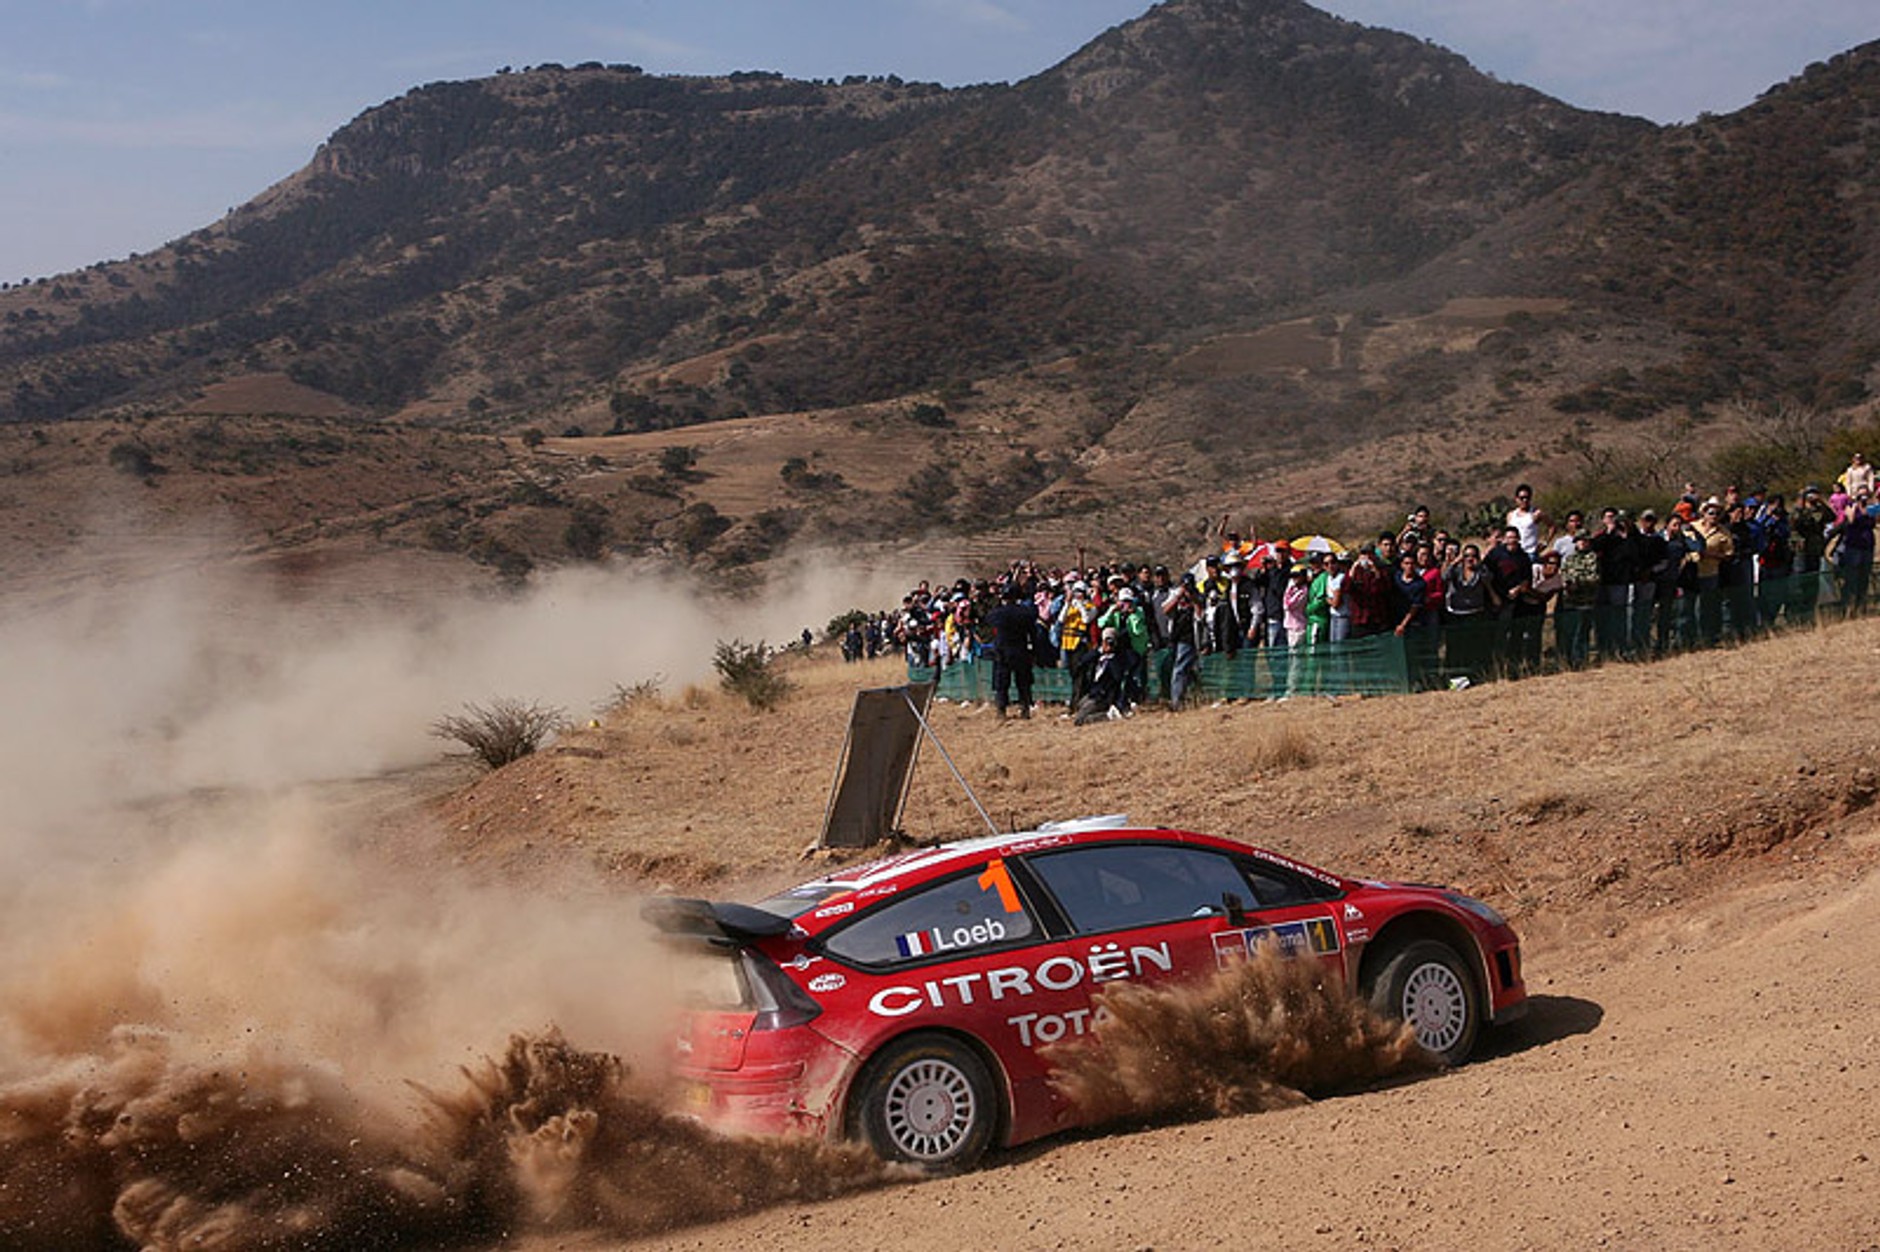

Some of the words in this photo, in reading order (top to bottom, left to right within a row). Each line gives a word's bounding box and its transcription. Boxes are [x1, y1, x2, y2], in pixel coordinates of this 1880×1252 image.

[978, 858, 1023, 913] 1
[933, 917, 1005, 950] Loeb
[1314, 921, 1328, 952] 1
[868, 942, 1172, 1017] CITROËN
[1008, 1004, 1118, 1047] TOTA
